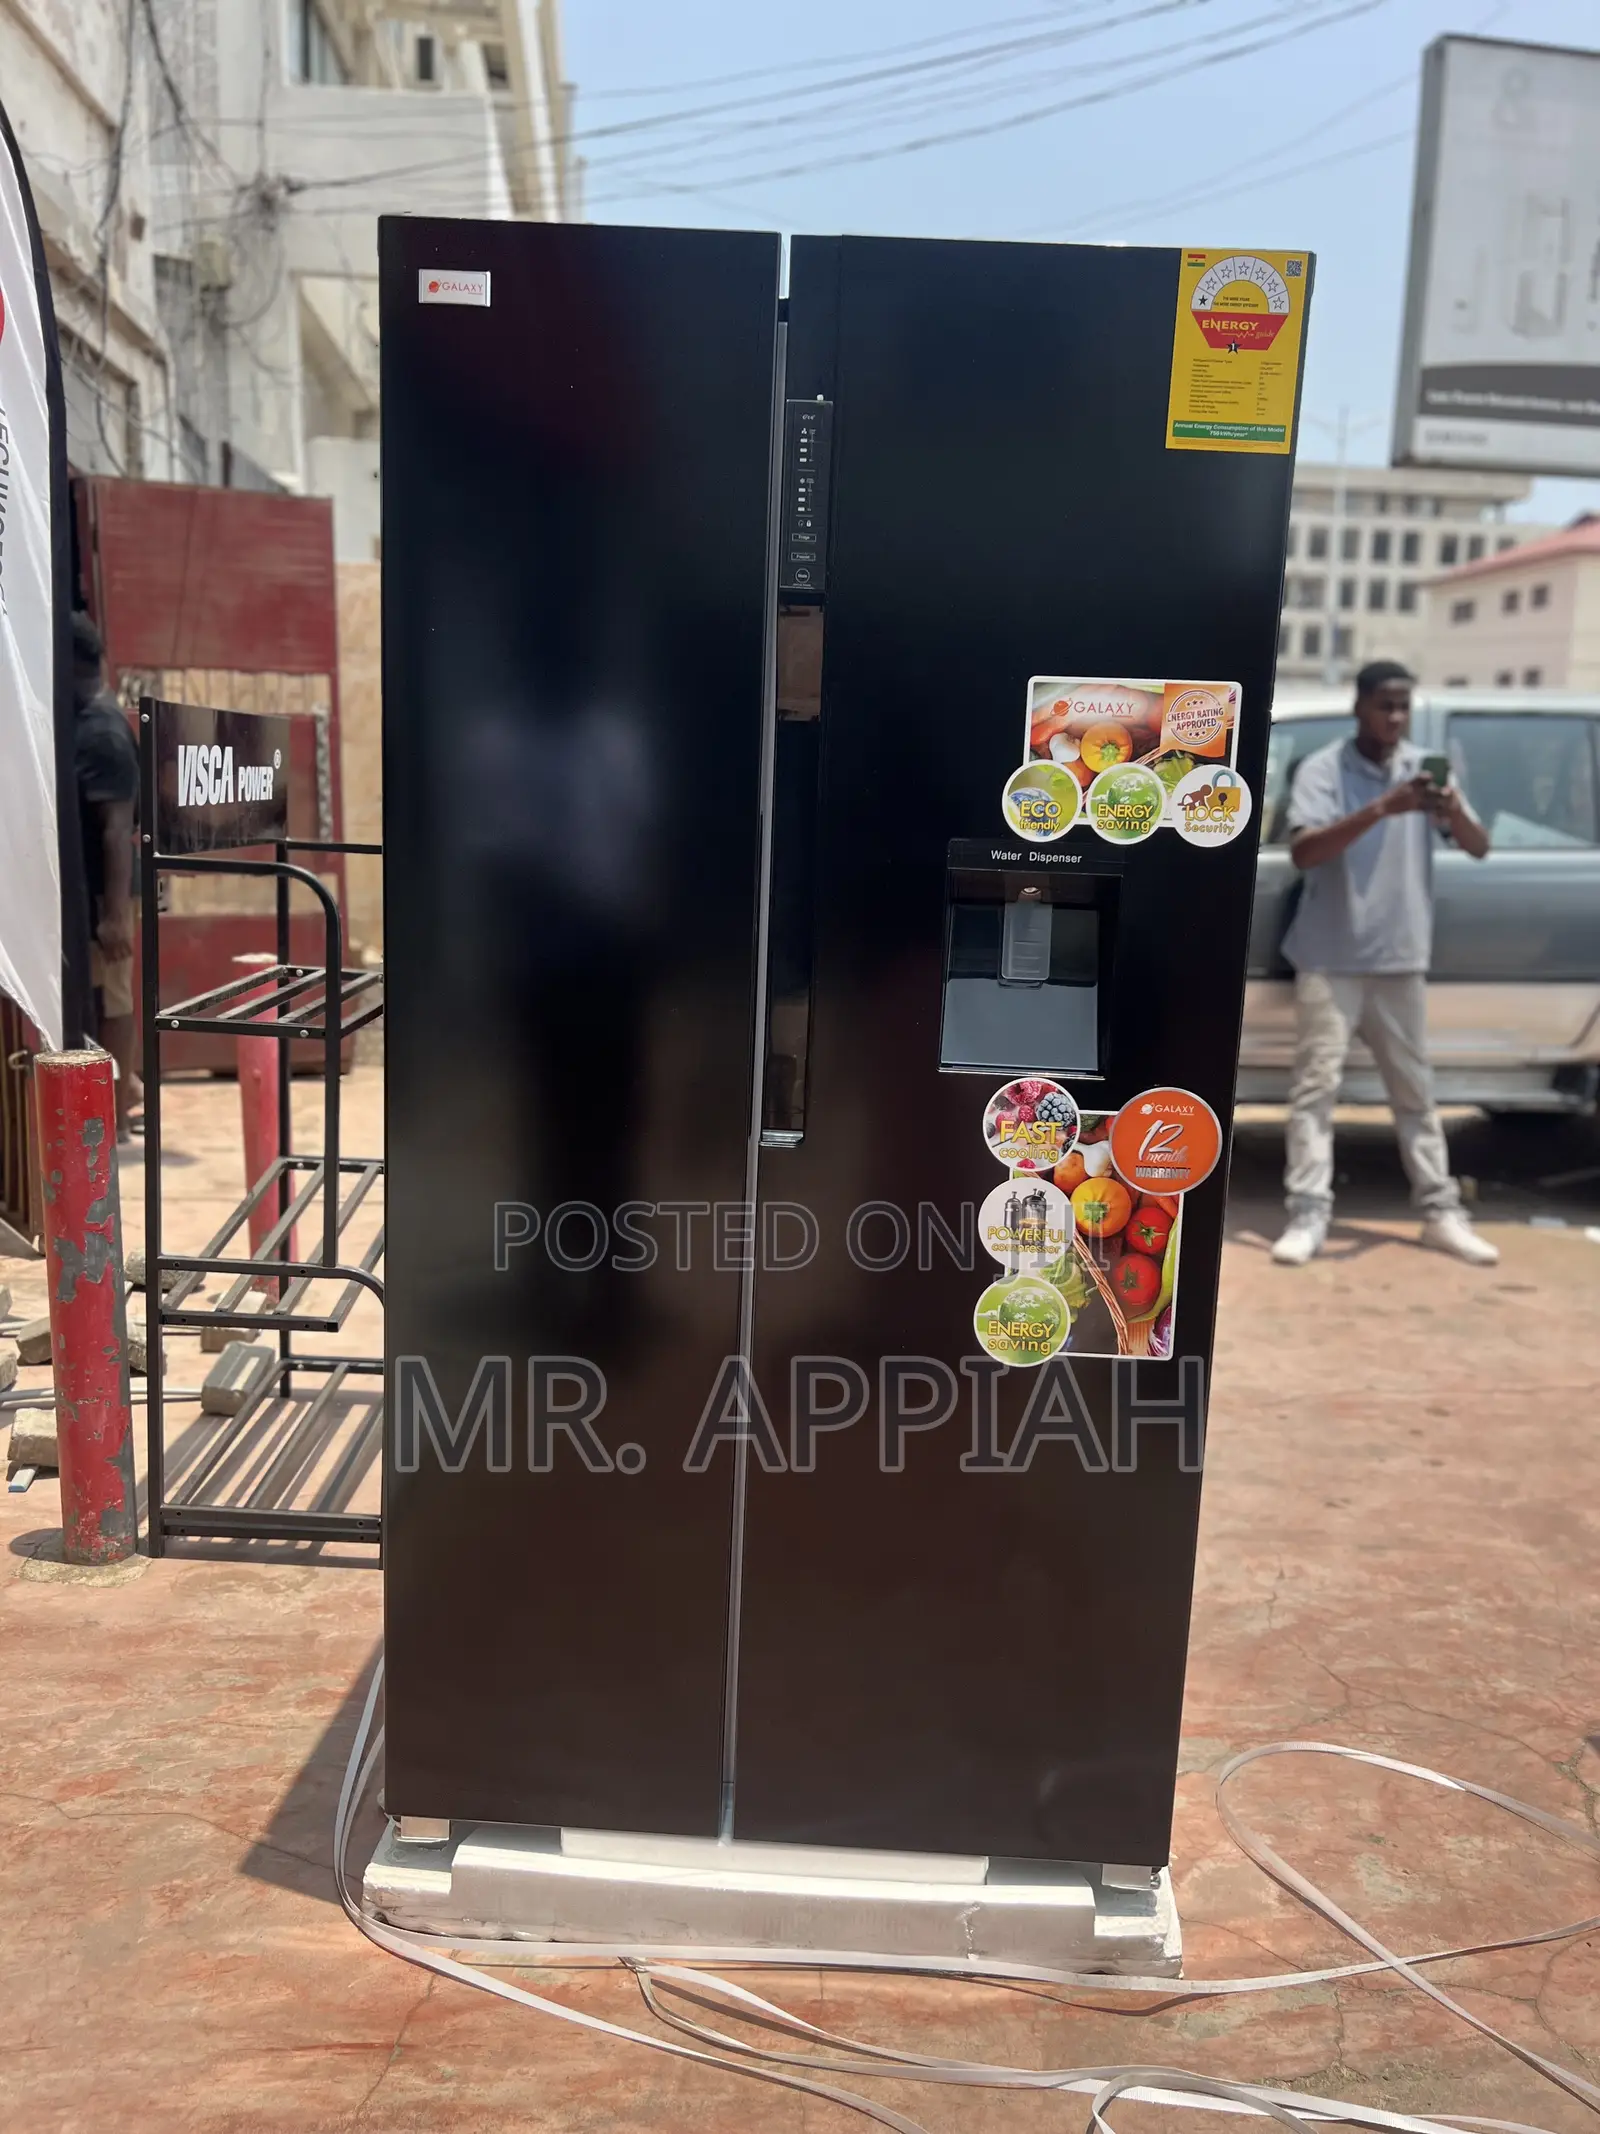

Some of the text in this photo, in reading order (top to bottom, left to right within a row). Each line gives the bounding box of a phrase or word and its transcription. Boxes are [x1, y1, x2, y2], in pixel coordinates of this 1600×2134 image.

[442, 281, 484, 292] GALAXY
[1202, 317, 1259, 332] ENERGY
[1194, 423, 1212, 431] Energy
[1073, 701, 1134, 714] GALAXY
[1168, 707, 1224, 722] ENERGY RATING
[1176, 717, 1217, 731] APPROVED
[178, 744, 235, 807] VISCA
[1020, 800, 1062, 819] ECO
[1097, 804, 1153, 820] ENERGY
[1184, 805, 1235, 822] LOCK
[1019, 819, 1060, 832] friendly
[1096, 817, 1151, 834] saving
[1183, 821, 1235, 836] Security
[991, 850, 1082, 864] Water Dispenser
[1154, 1104, 1195, 1113] GALAXY
[1000, 1120, 1062, 1145] FAST
[1138, 1119, 1185, 1161] 12
[998, 1144, 1059, 1163] cooling
[1135, 1166, 1191, 1180] WARRANTY
[987, 1226, 1070, 1243] POWERFUL
[991, 1243, 1061, 1255] compressor
[988, 1320, 1055, 1338] ENERGY
[988, 1336, 1052, 1356] saving
